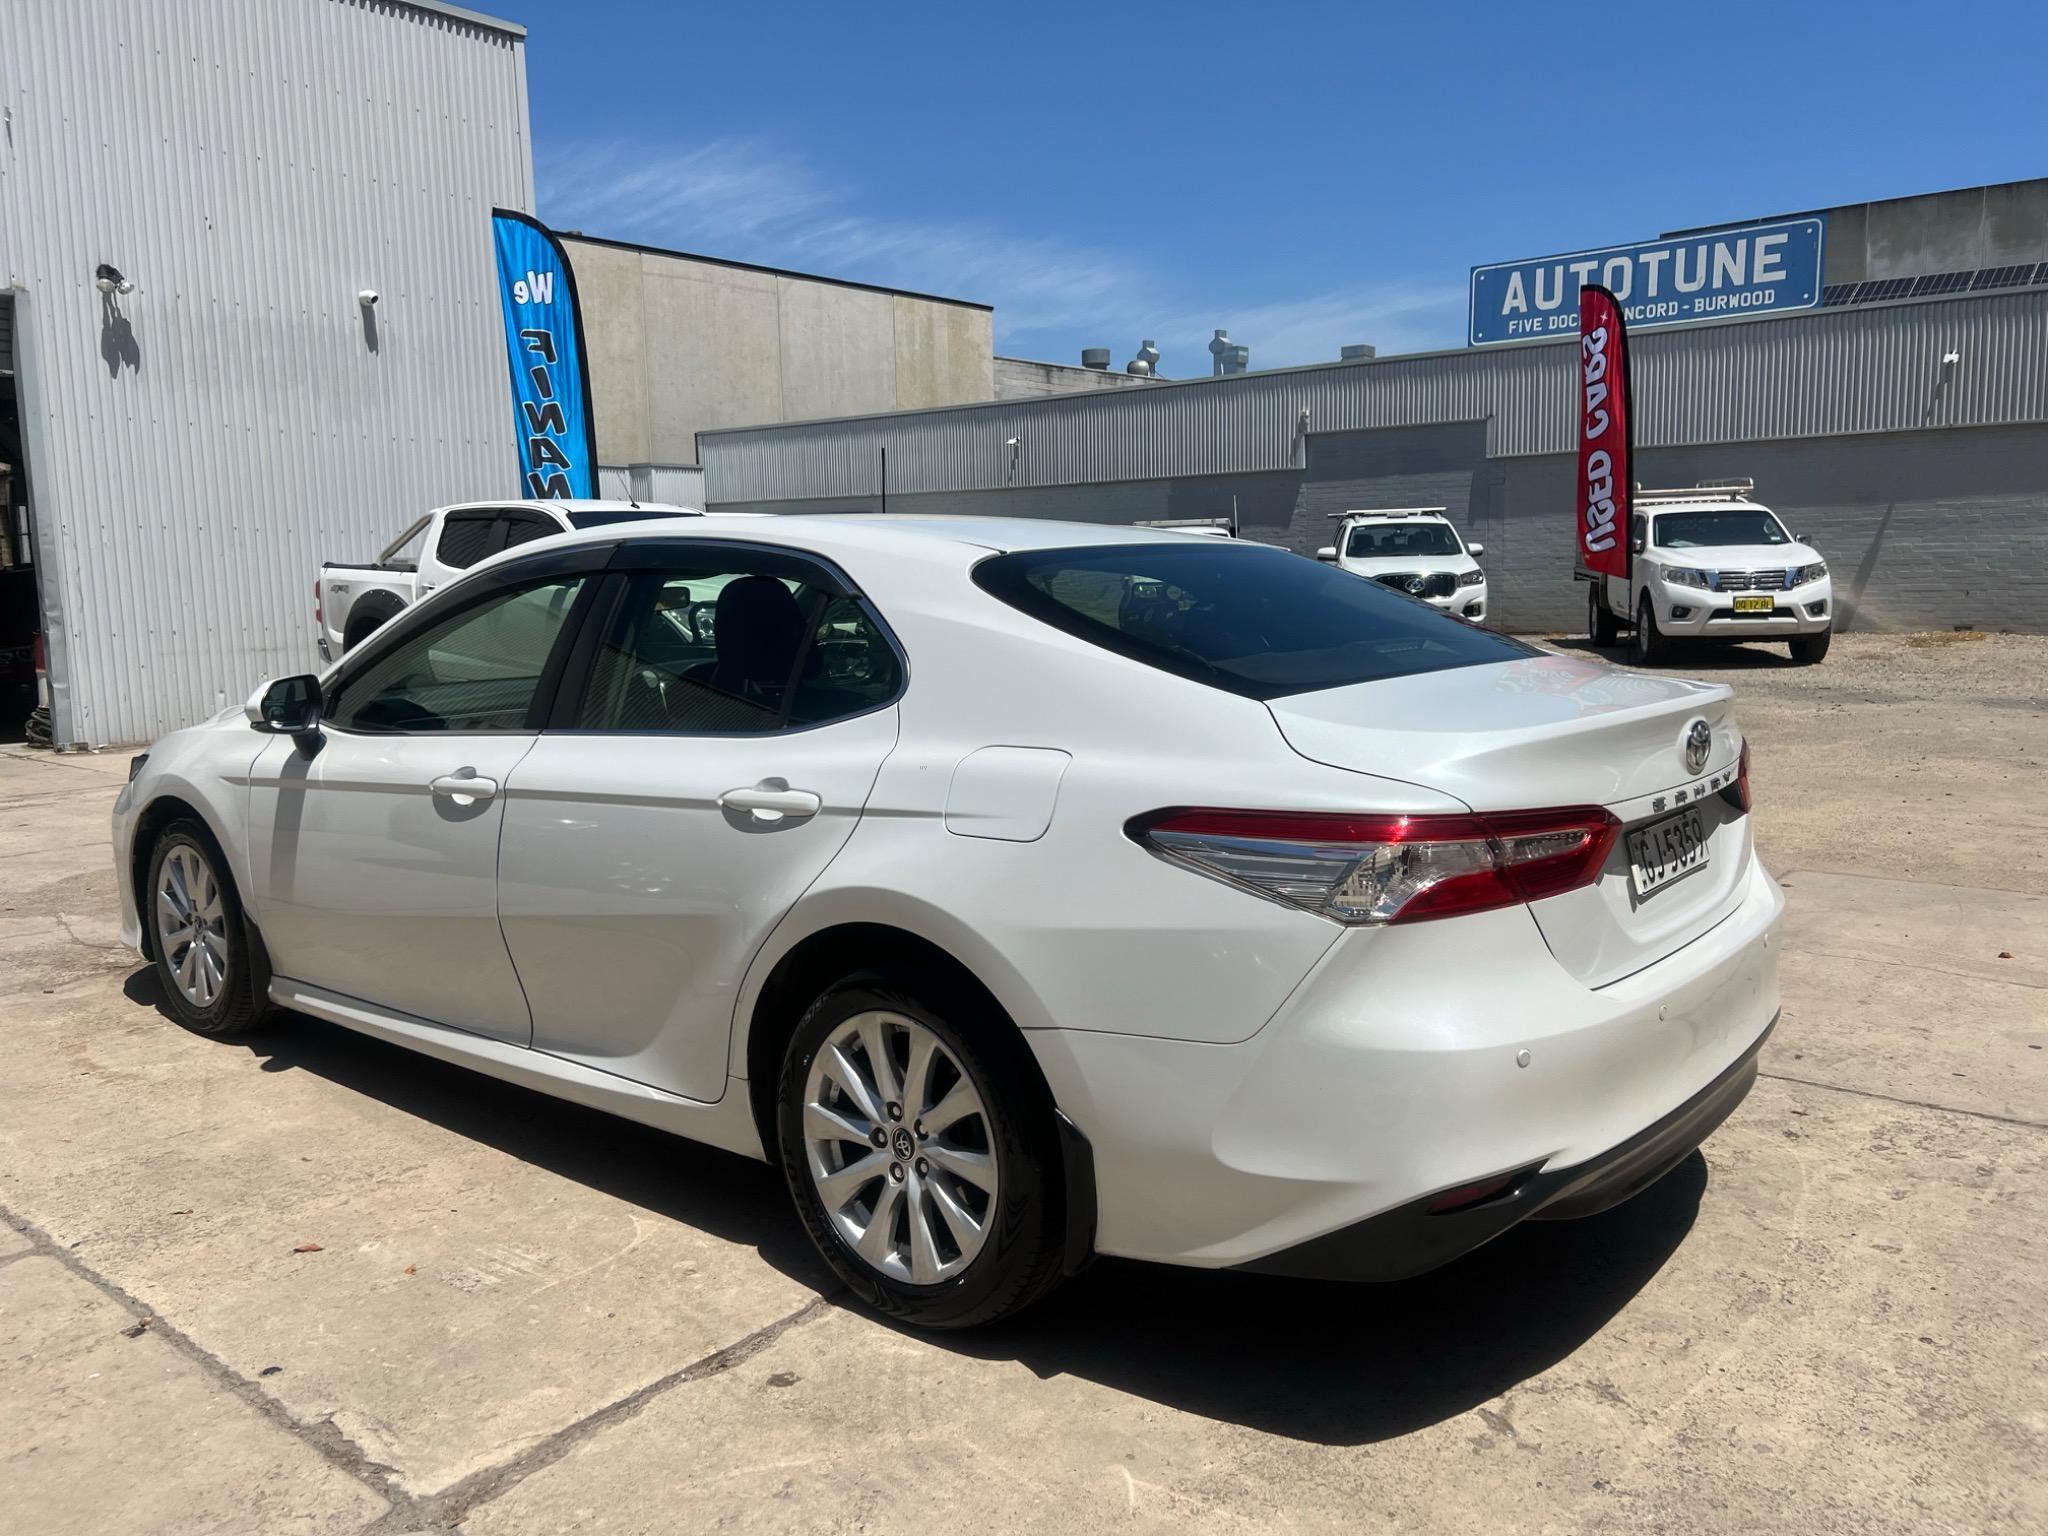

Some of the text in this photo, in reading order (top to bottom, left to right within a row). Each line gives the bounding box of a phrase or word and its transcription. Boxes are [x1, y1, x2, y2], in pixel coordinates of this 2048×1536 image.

[1502, 233, 1789, 315] AUTOTUNE
[1508, 316, 1543, 334] FIVE
[1549, 313, 1581, 329] DOC
[1624, 301, 1678, 321] NCORD
[1694, 289, 1776, 313] BURWOOD
